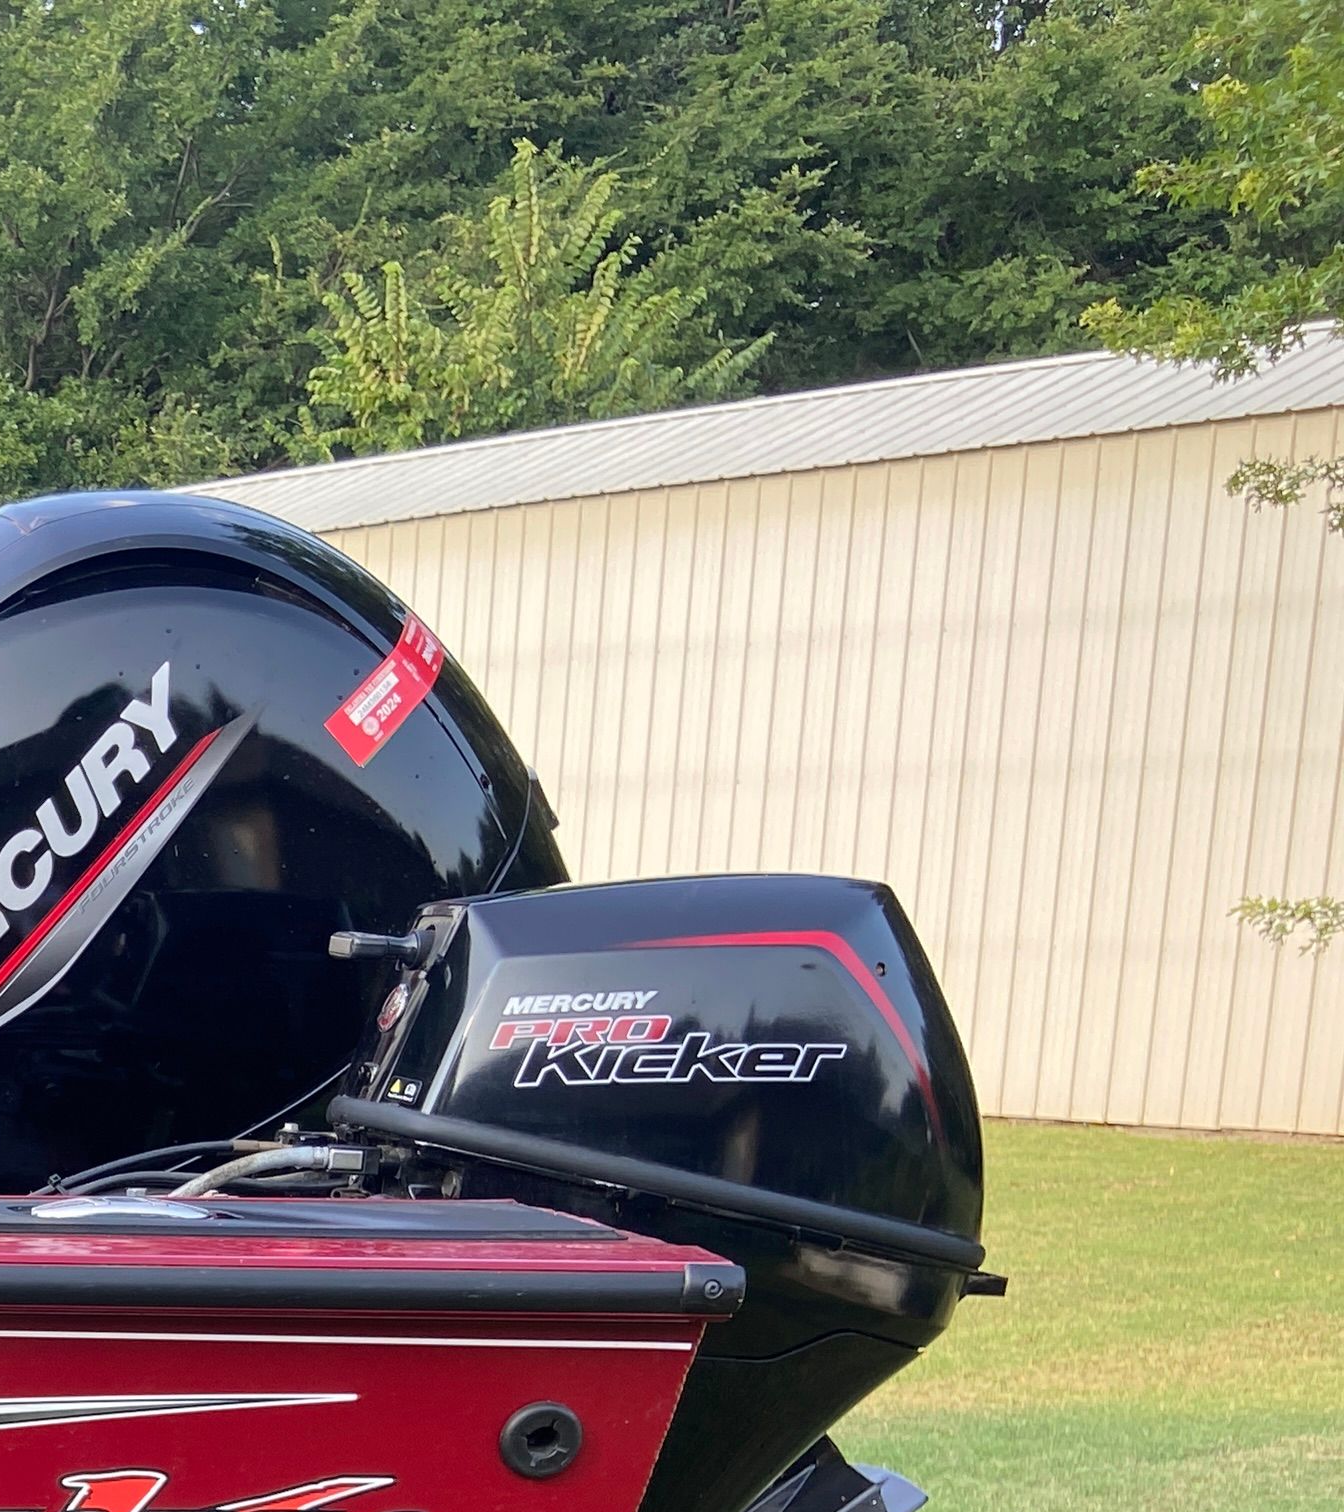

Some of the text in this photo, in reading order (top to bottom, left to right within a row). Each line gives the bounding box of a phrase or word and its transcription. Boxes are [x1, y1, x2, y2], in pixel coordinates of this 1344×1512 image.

[376, 692, 402, 722] 2024
[78, 777, 195, 915] FOURSTROKE
[503, 991, 659, 1016] MERCURY
[489, 1015, 672, 1050] PRO
[513, 1032, 848, 1088] Kicker
